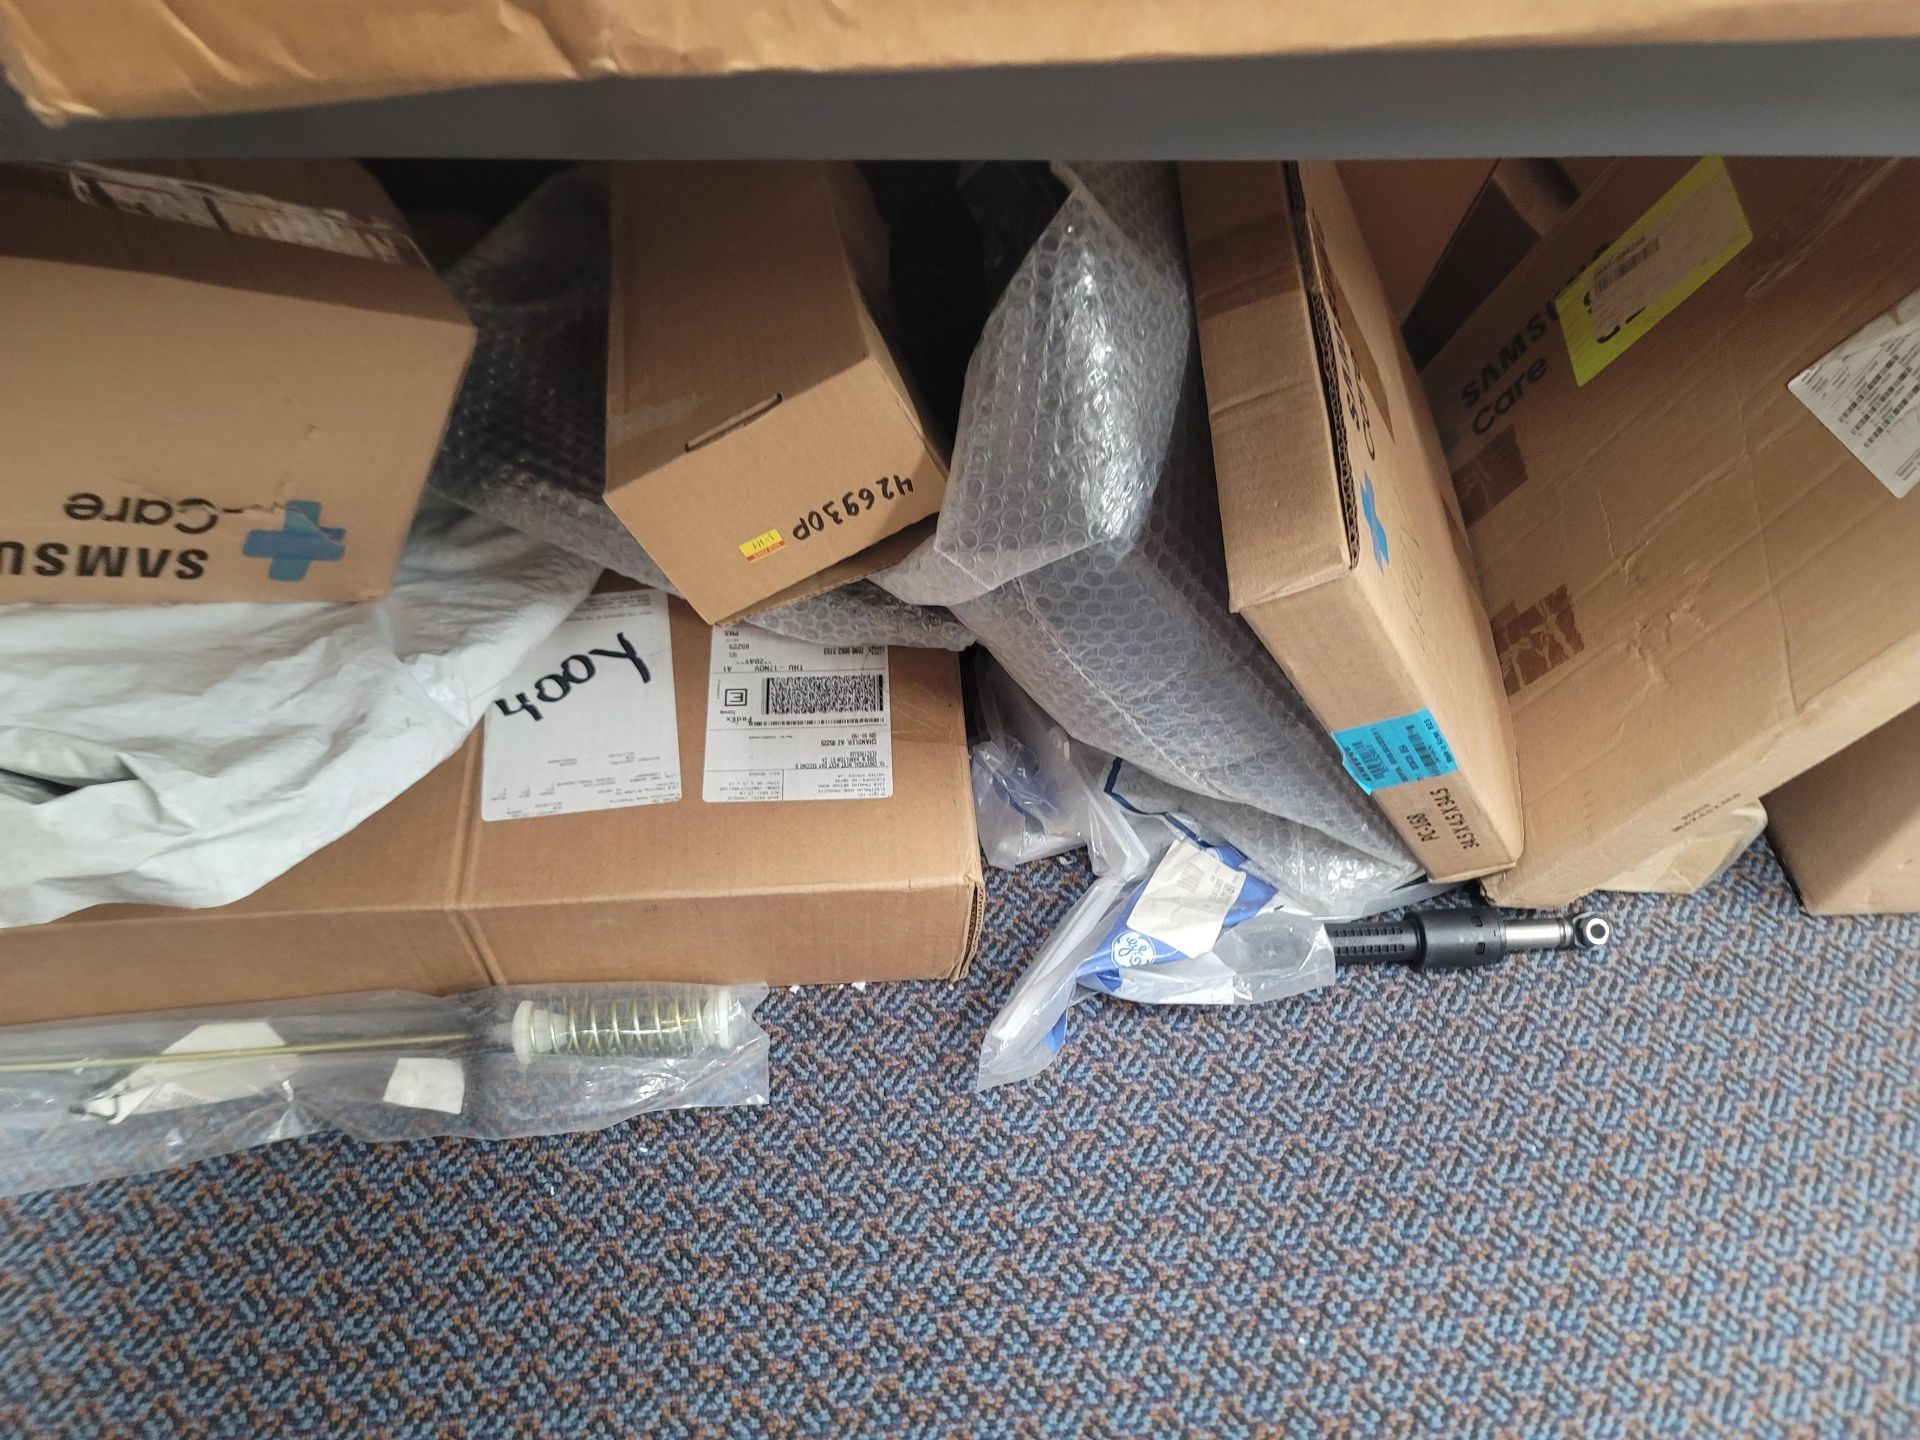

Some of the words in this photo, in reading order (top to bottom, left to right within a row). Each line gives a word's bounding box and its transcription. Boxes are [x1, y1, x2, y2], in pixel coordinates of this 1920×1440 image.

[1472, 356, 1548, 435] Care
[62, 492, 219, 535] Care
[792, 474, 914, 541] 426930P
